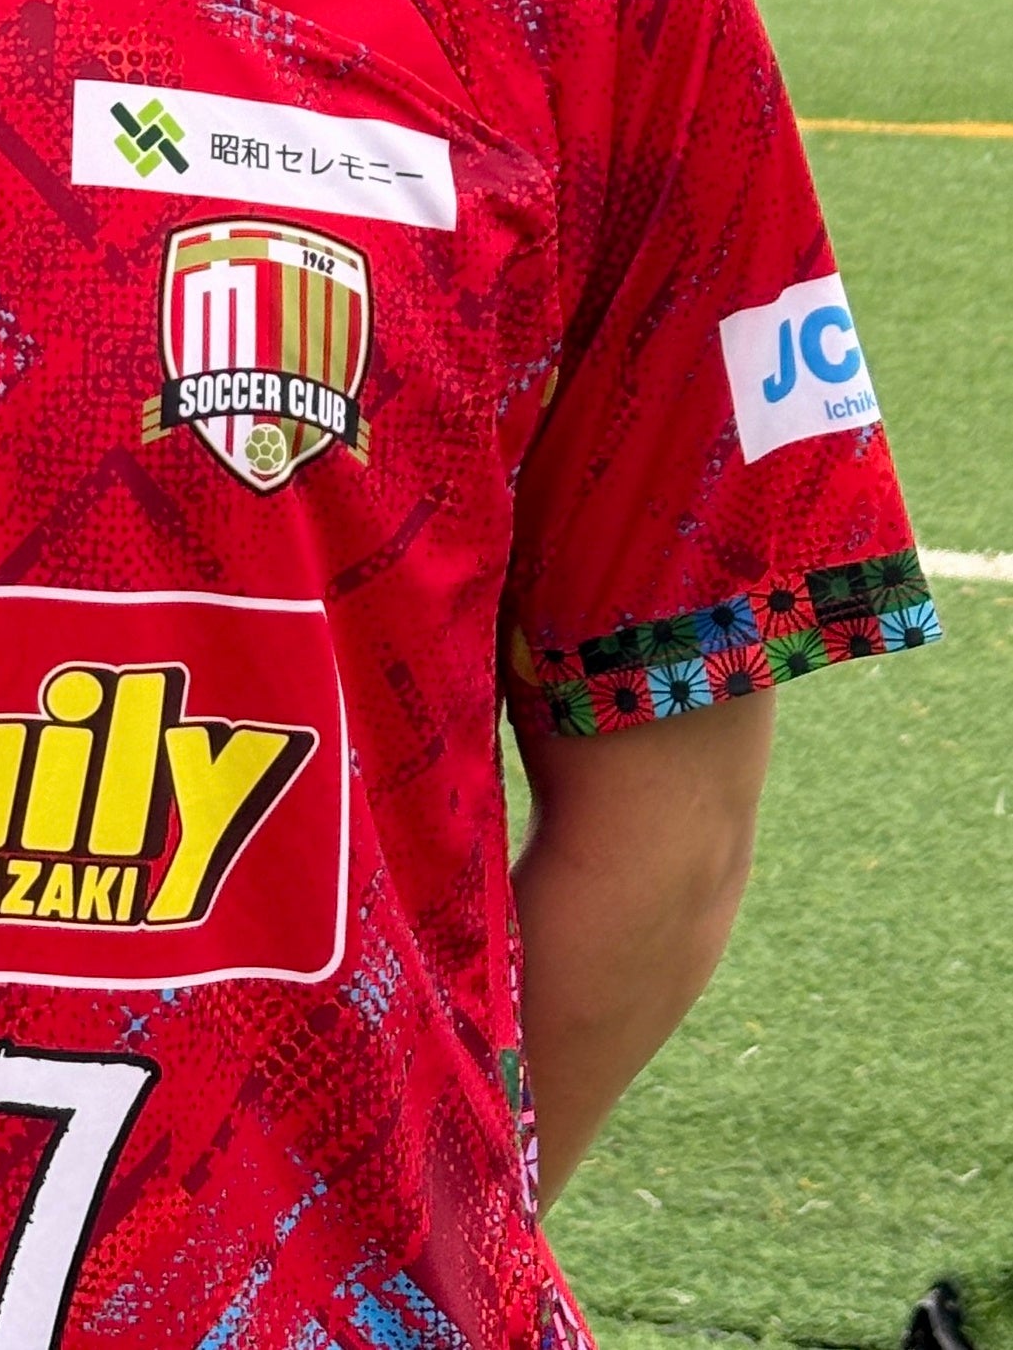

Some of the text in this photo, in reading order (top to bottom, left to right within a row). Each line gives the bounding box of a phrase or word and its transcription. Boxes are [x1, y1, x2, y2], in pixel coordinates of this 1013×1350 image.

[210, 132, 424, 185] 昭和セレモニー
[302, 250, 336, 276] 1962
[762, 305, 861, 404] JC
[178, 371, 348, 435] SOCCER CLUB
